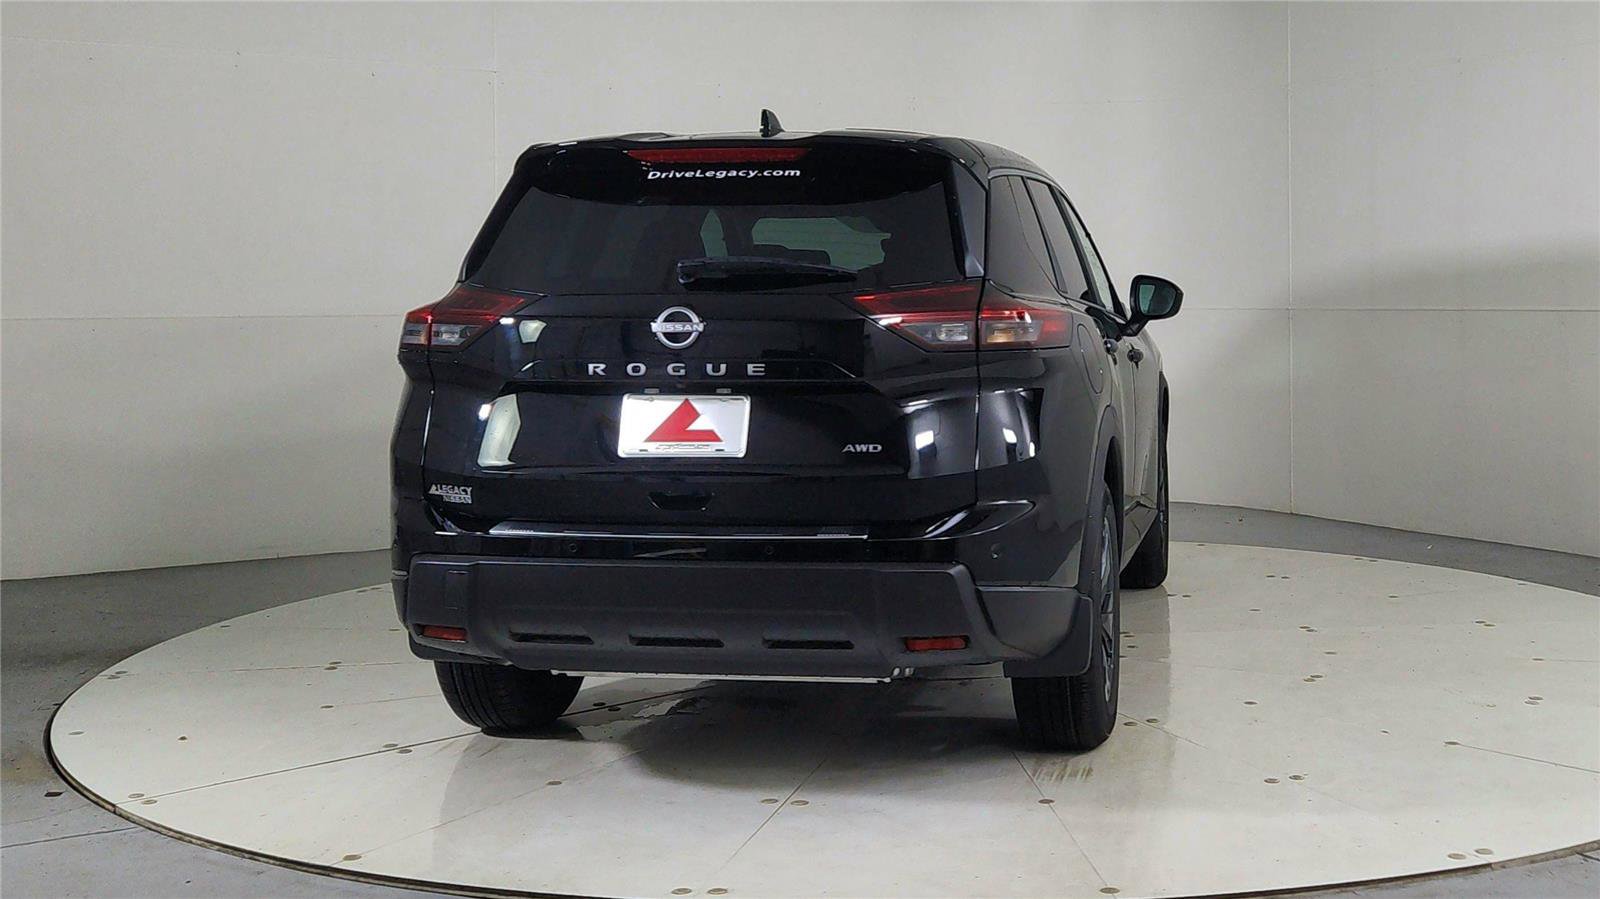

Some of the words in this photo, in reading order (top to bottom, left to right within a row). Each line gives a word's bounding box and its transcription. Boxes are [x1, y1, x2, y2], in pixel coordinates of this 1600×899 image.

[647, 168, 801, 180] DriveLegacy.com
[653, 323, 702, 332] NISSAN
[587, 363, 766, 376] ROGUE
[841, 444, 882, 453] AWD
[437, 484, 473, 496] LEGACY
